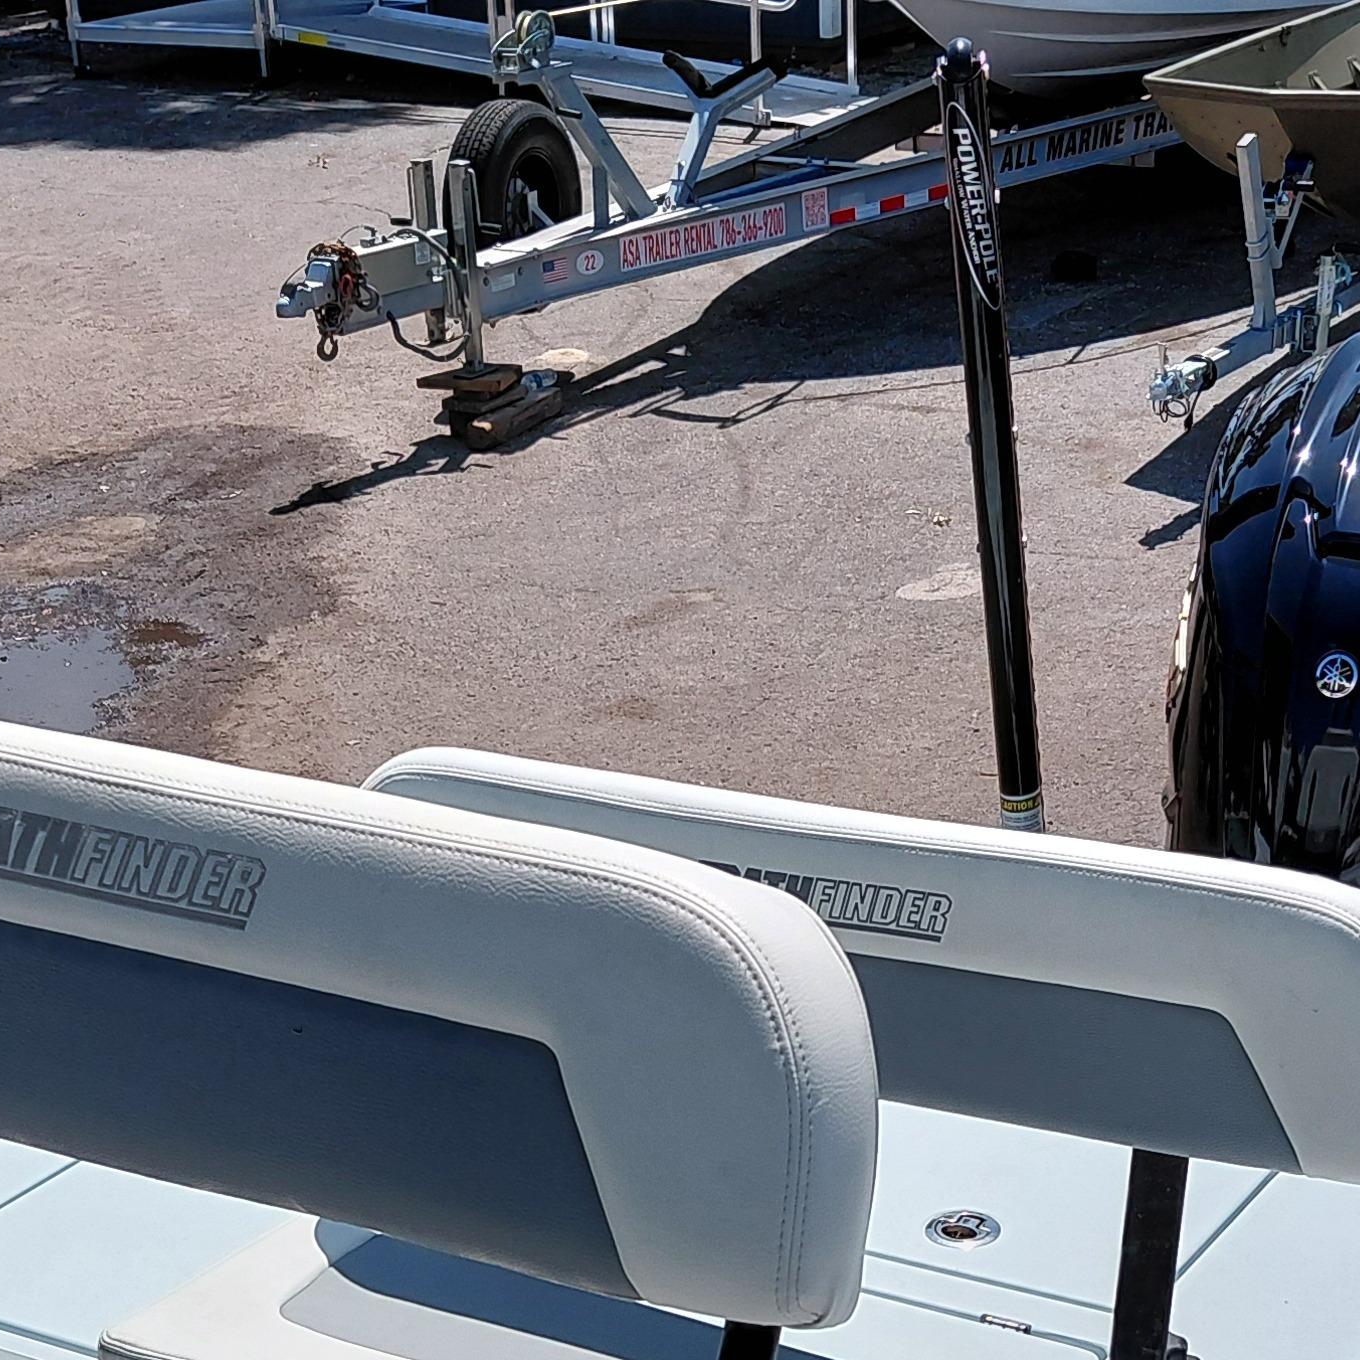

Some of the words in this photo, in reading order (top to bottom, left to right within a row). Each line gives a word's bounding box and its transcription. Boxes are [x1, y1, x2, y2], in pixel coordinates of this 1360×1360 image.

[1000, 140, 1039, 174] ALL
[1046, 116, 1126, 162] MARINE
[952, 128, 998, 284] POWER-POLE
[960, 199, 973, 235] WATER
[622, 236, 641, 269] ASA
[642, 227, 682, 265] TRAILER
[683, 221, 718, 256] RENTAL
[718, 206, 785, 248] 786-366-9200
[583, 254, 597, 272] 22
[1003, 799, 1034, 811] AUTION
